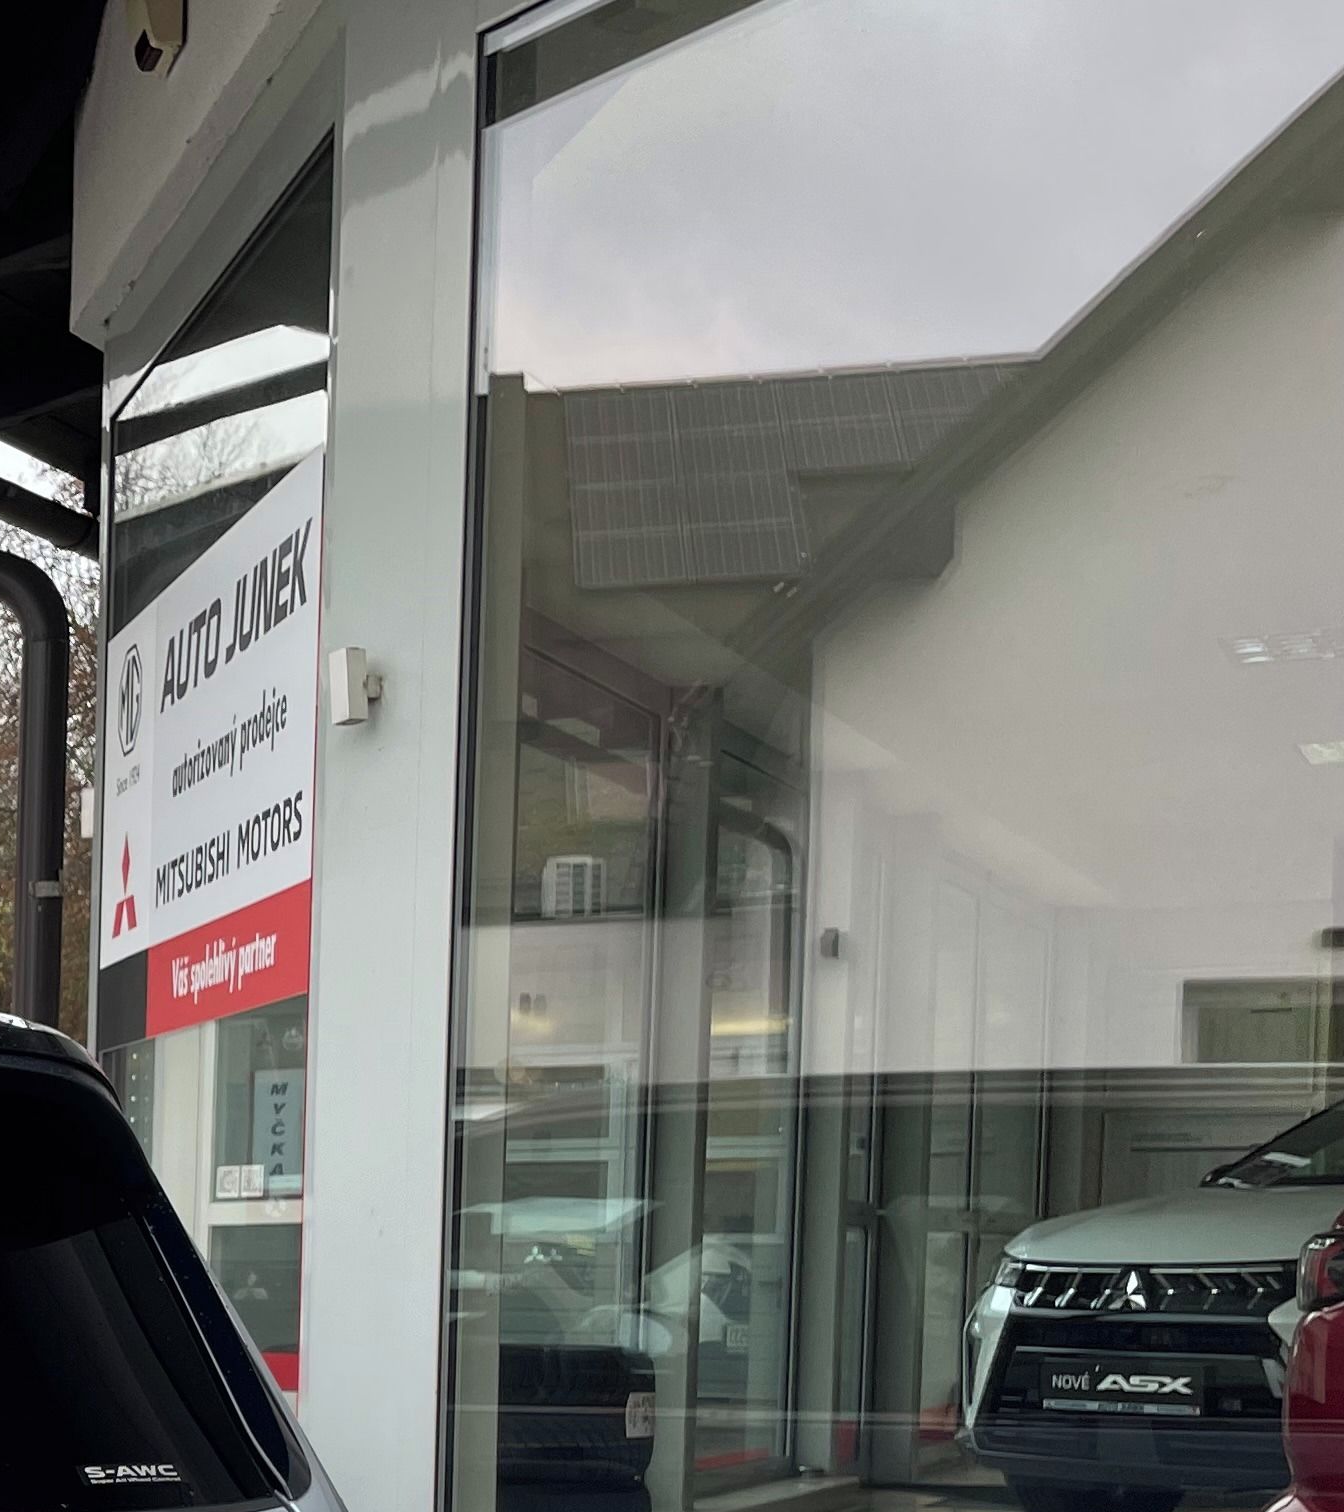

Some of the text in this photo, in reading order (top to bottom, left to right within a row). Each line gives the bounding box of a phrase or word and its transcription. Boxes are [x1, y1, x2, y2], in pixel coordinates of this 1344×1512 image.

[160, 517, 312, 714] AUTO JUNEK
[172, 687, 287, 797] autorizovaný prodejce
[156, 790, 302, 908] MITSUBISHI MOTORS
[171, 932, 277, 1005] Váš spolehlivý partner
[270, 1081, 289, 1176] MYČKA
[1052, 1371, 1193, 1396] NOVÉ ASX
[84, 1465, 178, 1479] S-AWC
